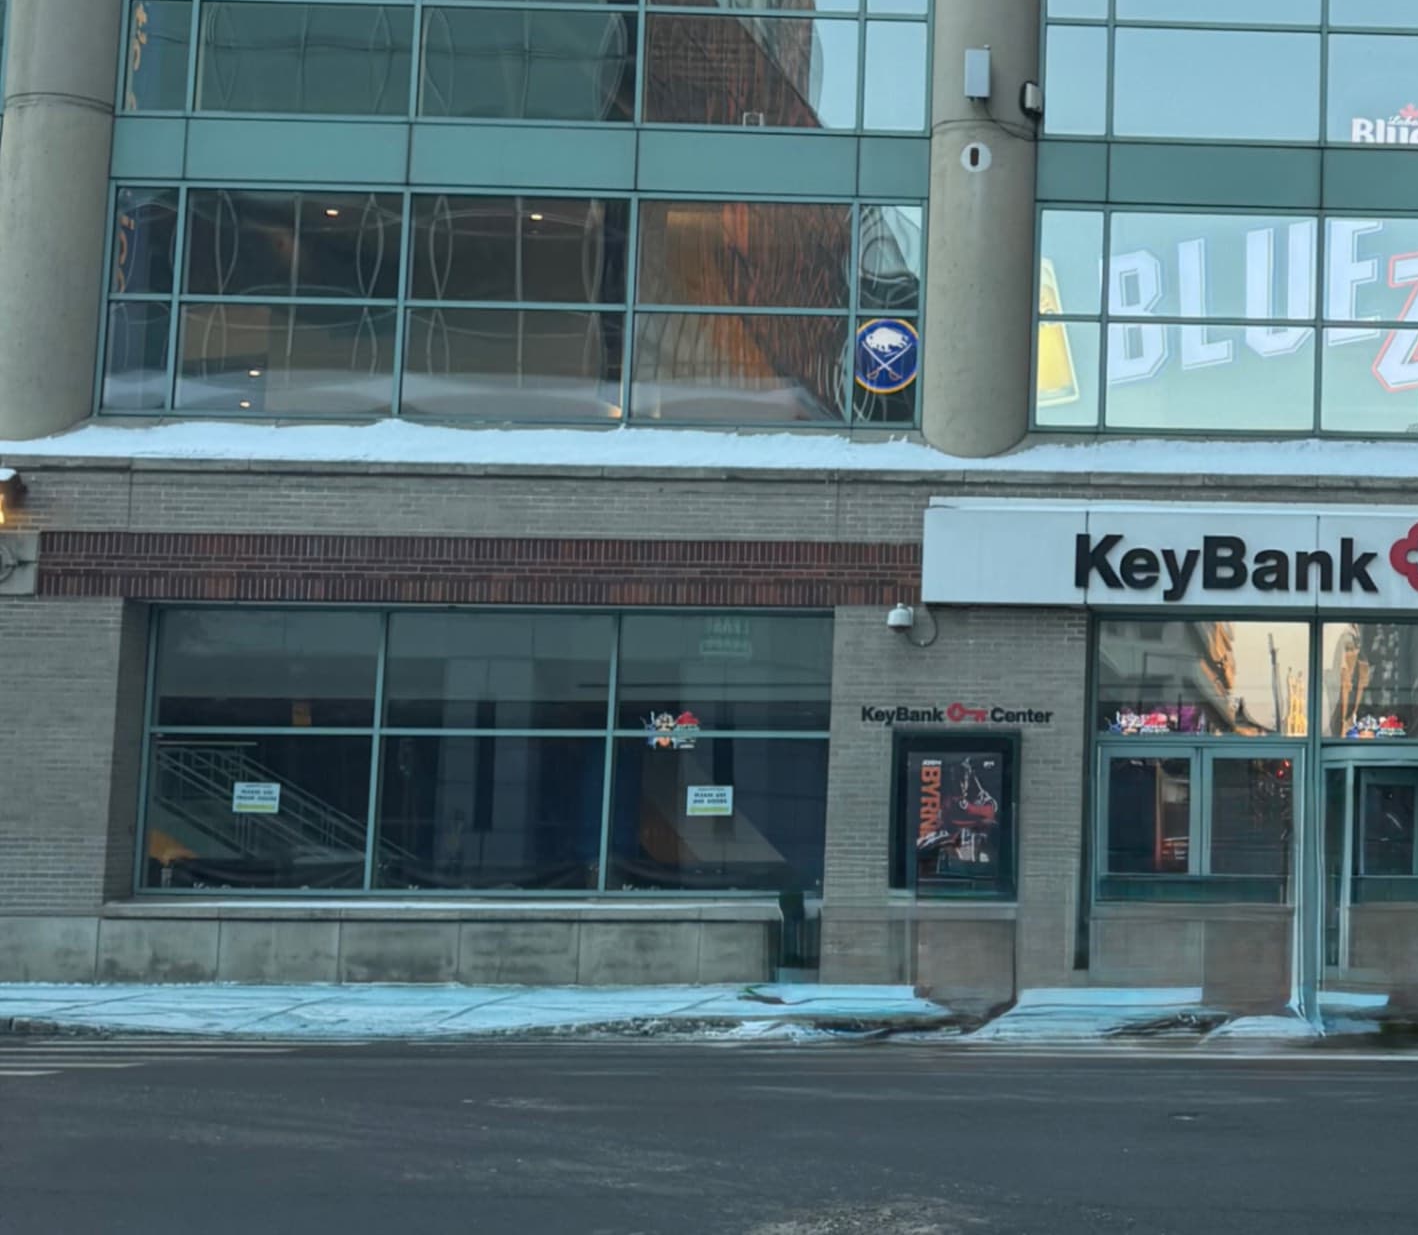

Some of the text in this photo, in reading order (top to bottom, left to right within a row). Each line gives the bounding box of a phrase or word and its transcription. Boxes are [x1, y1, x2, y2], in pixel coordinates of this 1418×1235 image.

[1100, 219, 1384, 385] BLUE
[1075, 533, 1378, 602] KeyBank
[861, 706, 1053, 725] KeyBank Center
